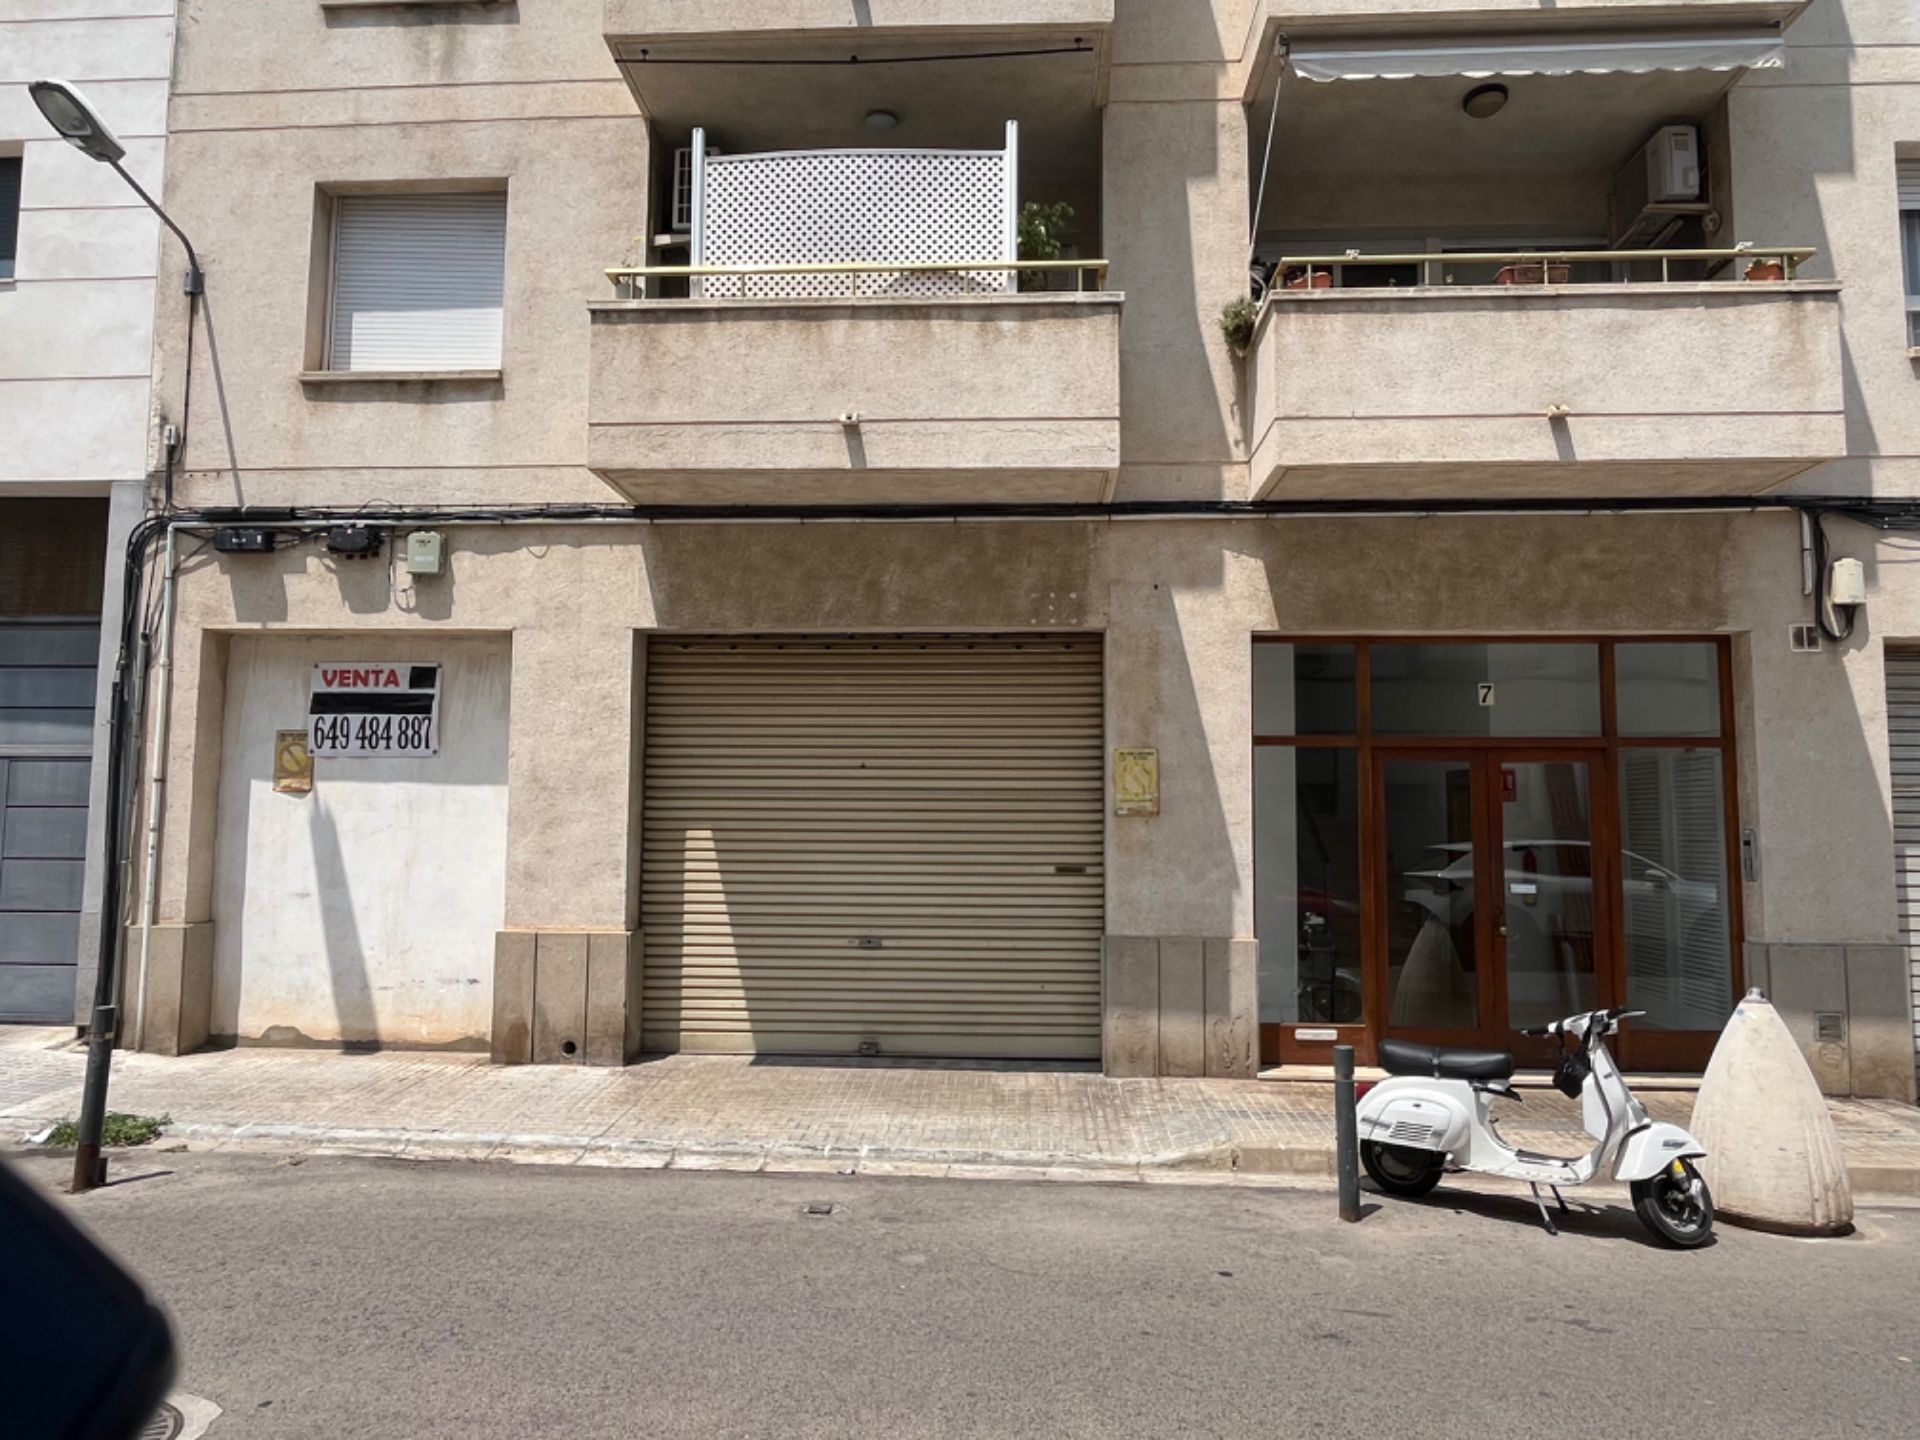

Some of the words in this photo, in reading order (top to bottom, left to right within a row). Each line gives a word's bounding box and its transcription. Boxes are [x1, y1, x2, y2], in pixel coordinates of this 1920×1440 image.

[322, 669, 400, 688] VENTA
[1479, 685, 1493, 703] 7
[314, 716, 351, 750] 649
[355, 716, 392, 750] 484
[397, 716, 432, 750] 887
